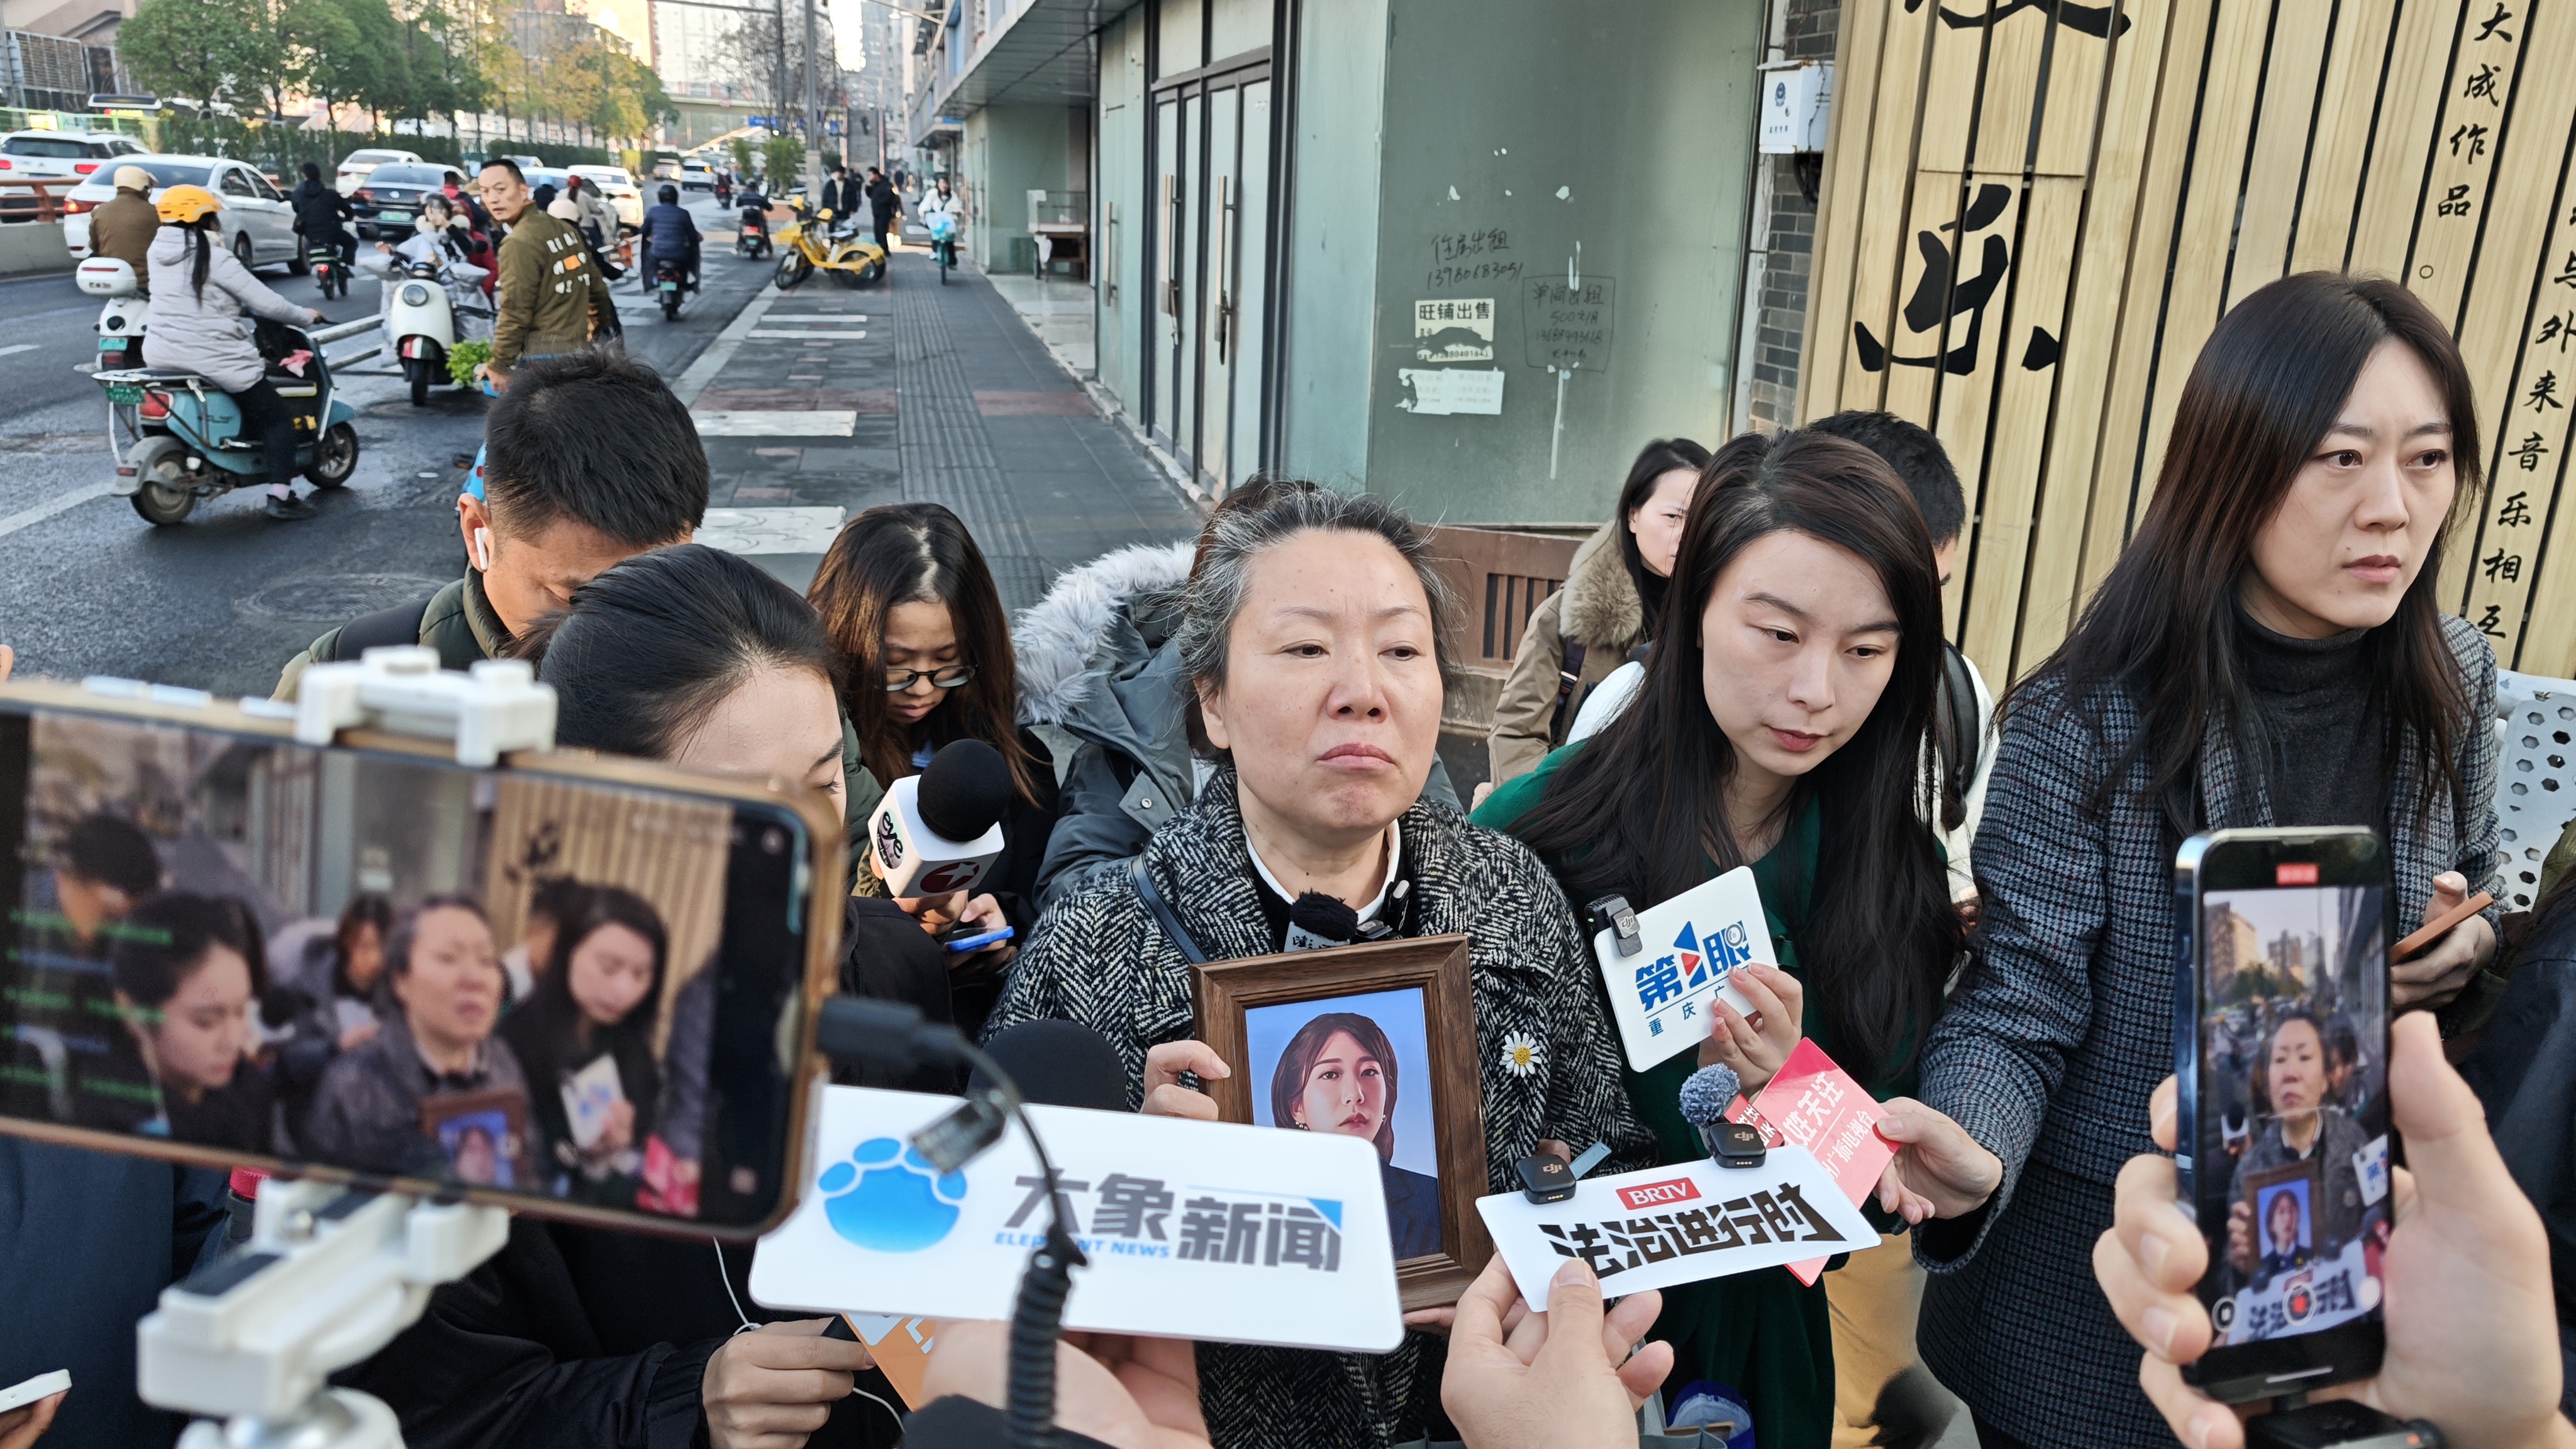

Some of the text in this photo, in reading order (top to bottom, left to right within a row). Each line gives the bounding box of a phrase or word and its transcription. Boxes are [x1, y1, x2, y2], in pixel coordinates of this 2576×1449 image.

[1419, 302, 1490, 320] 旺铺出售
[2477, 206, 2576, 639] 与外来音乐相互
[882, 811, 903, 859] eye
[1627, 1182, 1687, 1206] BRTV
[1004, 1168, 1342, 1272] 大象新闻
[1537, 1182, 1848, 1280] 法治进行时
[994, 1231, 1170, 1258] ELEPNT NEWS
